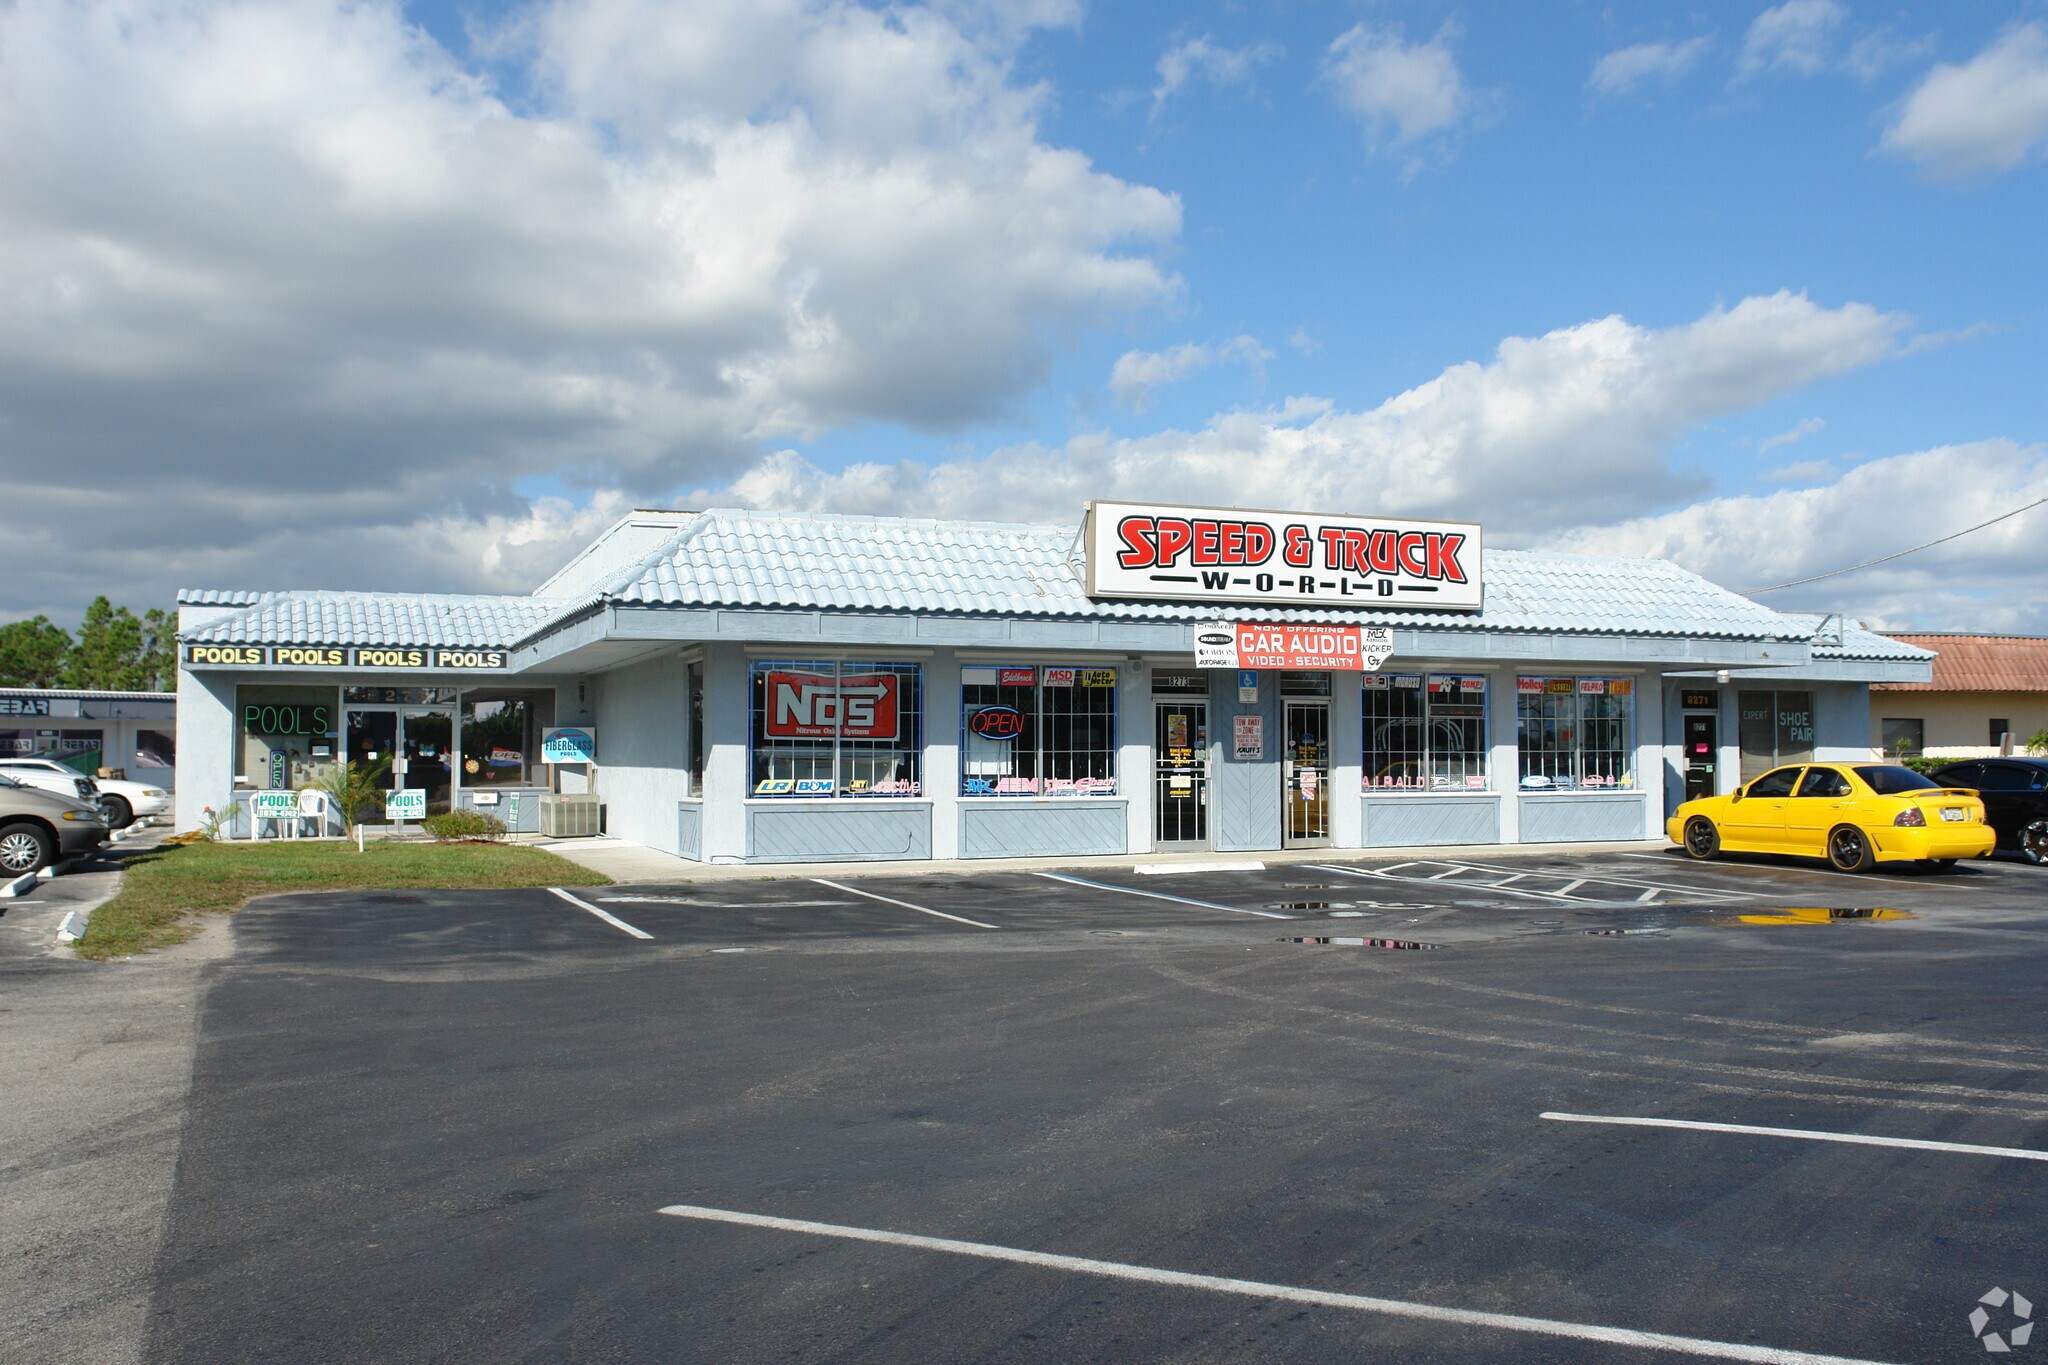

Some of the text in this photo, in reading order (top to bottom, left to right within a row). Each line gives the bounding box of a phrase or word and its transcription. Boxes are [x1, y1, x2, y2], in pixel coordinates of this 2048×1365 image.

[1117, 515, 1468, 584] SPEED & TRUCK
[1241, 632, 1357, 655] CAR AUDIO
[1362, 644, 1392, 653] KICKER
[193, 647, 501, 667] POOLS POOLS POOLS POOLS
[1247, 656, 1285, 666] VIDEO
[1296, 656, 1354, 667] SECURITY
[1049, 670, 1073, 680] MSD
[1517, 678, 1544, 692] Holley
[776, 682, 889, 727] NOS
[1687, 695, 1708, 705] 8271
[245, 705, 328, 735] POOLS
[971, 713, 1025, 733] OPEN
[1743, 710, 1809, 726] EXPERT SHOE
[1791, 727, 1813, 741] PAIR
[545, 740, 593, 751] FIBERGLASS
[273, 753, 283, 788] OPEN
[994, 778, 1039, 792] AEM
[259, 795, 297, 807] POOLS
[387, 795, 423, 807] POOLS
